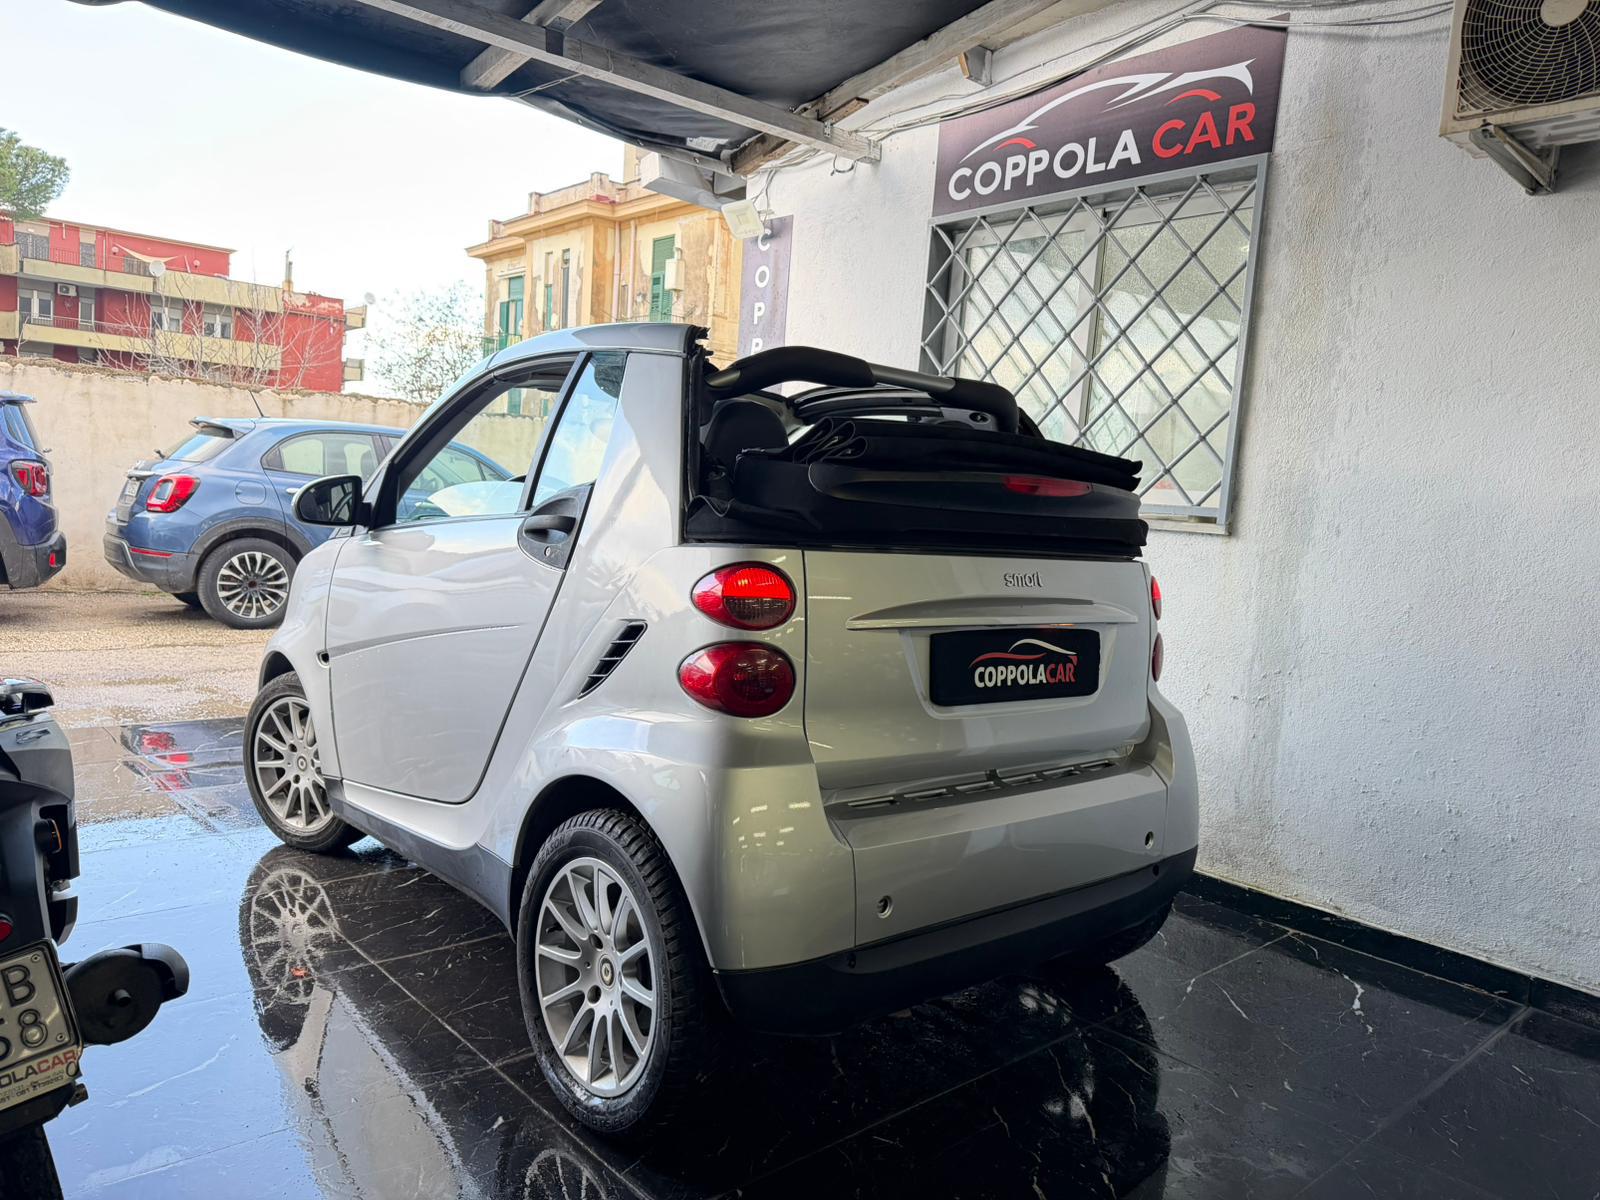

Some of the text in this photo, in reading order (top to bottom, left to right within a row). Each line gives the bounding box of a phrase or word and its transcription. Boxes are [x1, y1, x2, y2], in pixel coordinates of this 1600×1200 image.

[948, 102, 1256, 201] COPPOLA CAR
[1004, 571, 1043, 588] smart
[974, 663, 1076, 688] COPPOLACAR
